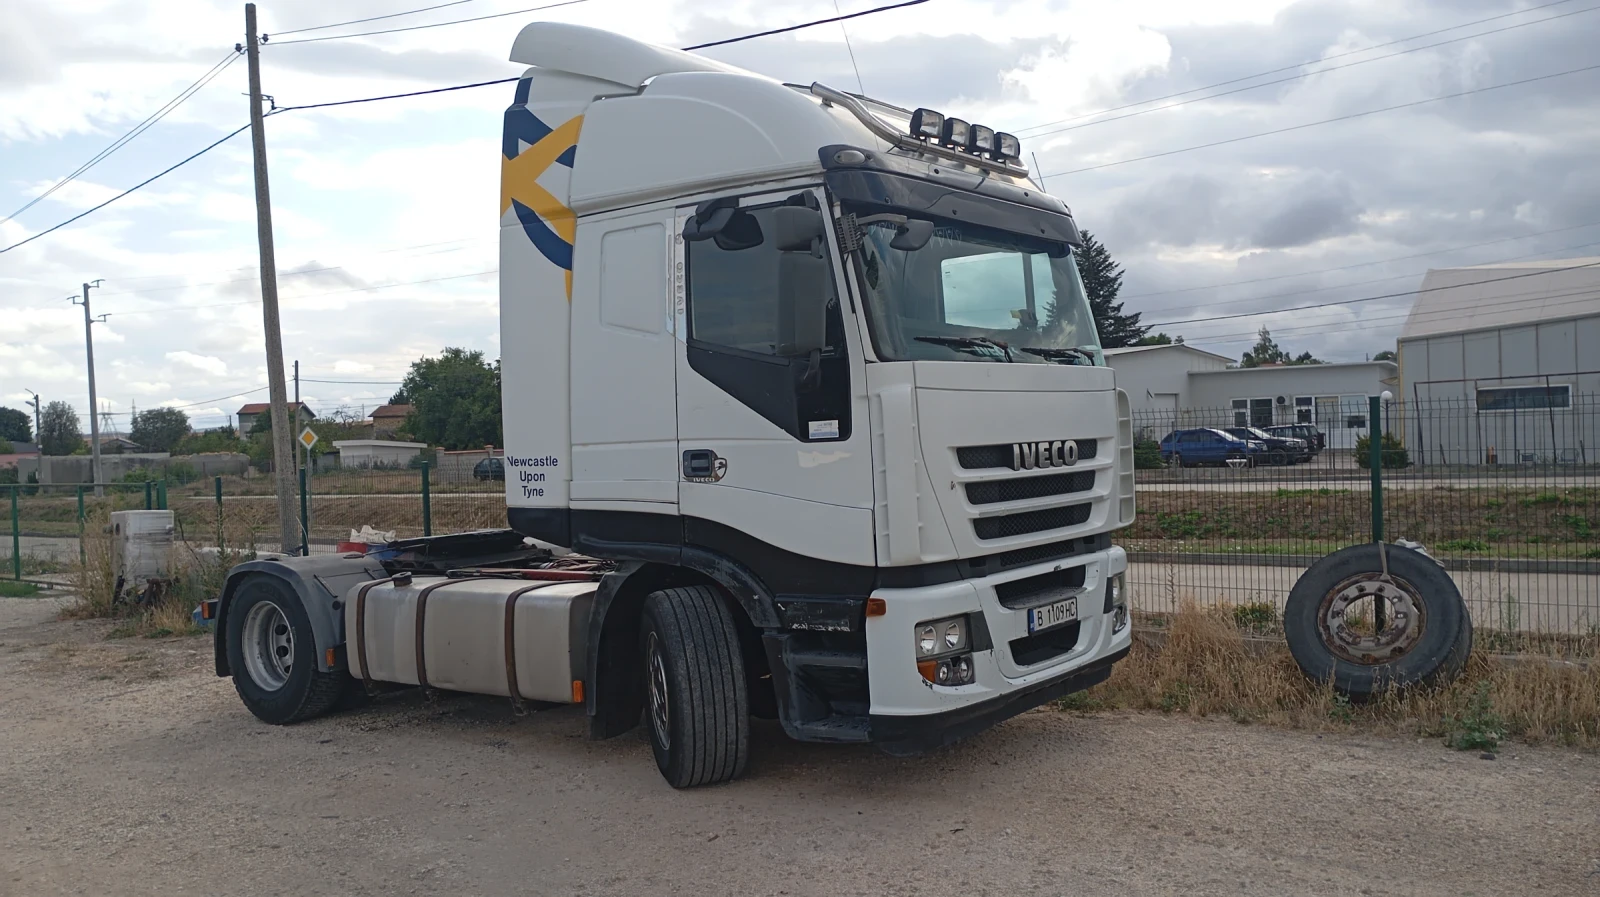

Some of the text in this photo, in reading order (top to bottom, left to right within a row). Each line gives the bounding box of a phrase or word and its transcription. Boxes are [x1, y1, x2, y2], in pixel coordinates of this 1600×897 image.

[507, 456, 558, 466] Newcastle
[1012, 439, 1079, 471] IVECO
[520, 471, 545, 483] Upon
[521, 485, 544, 499] Tyne
[1037, 610, 1044, 627] B
